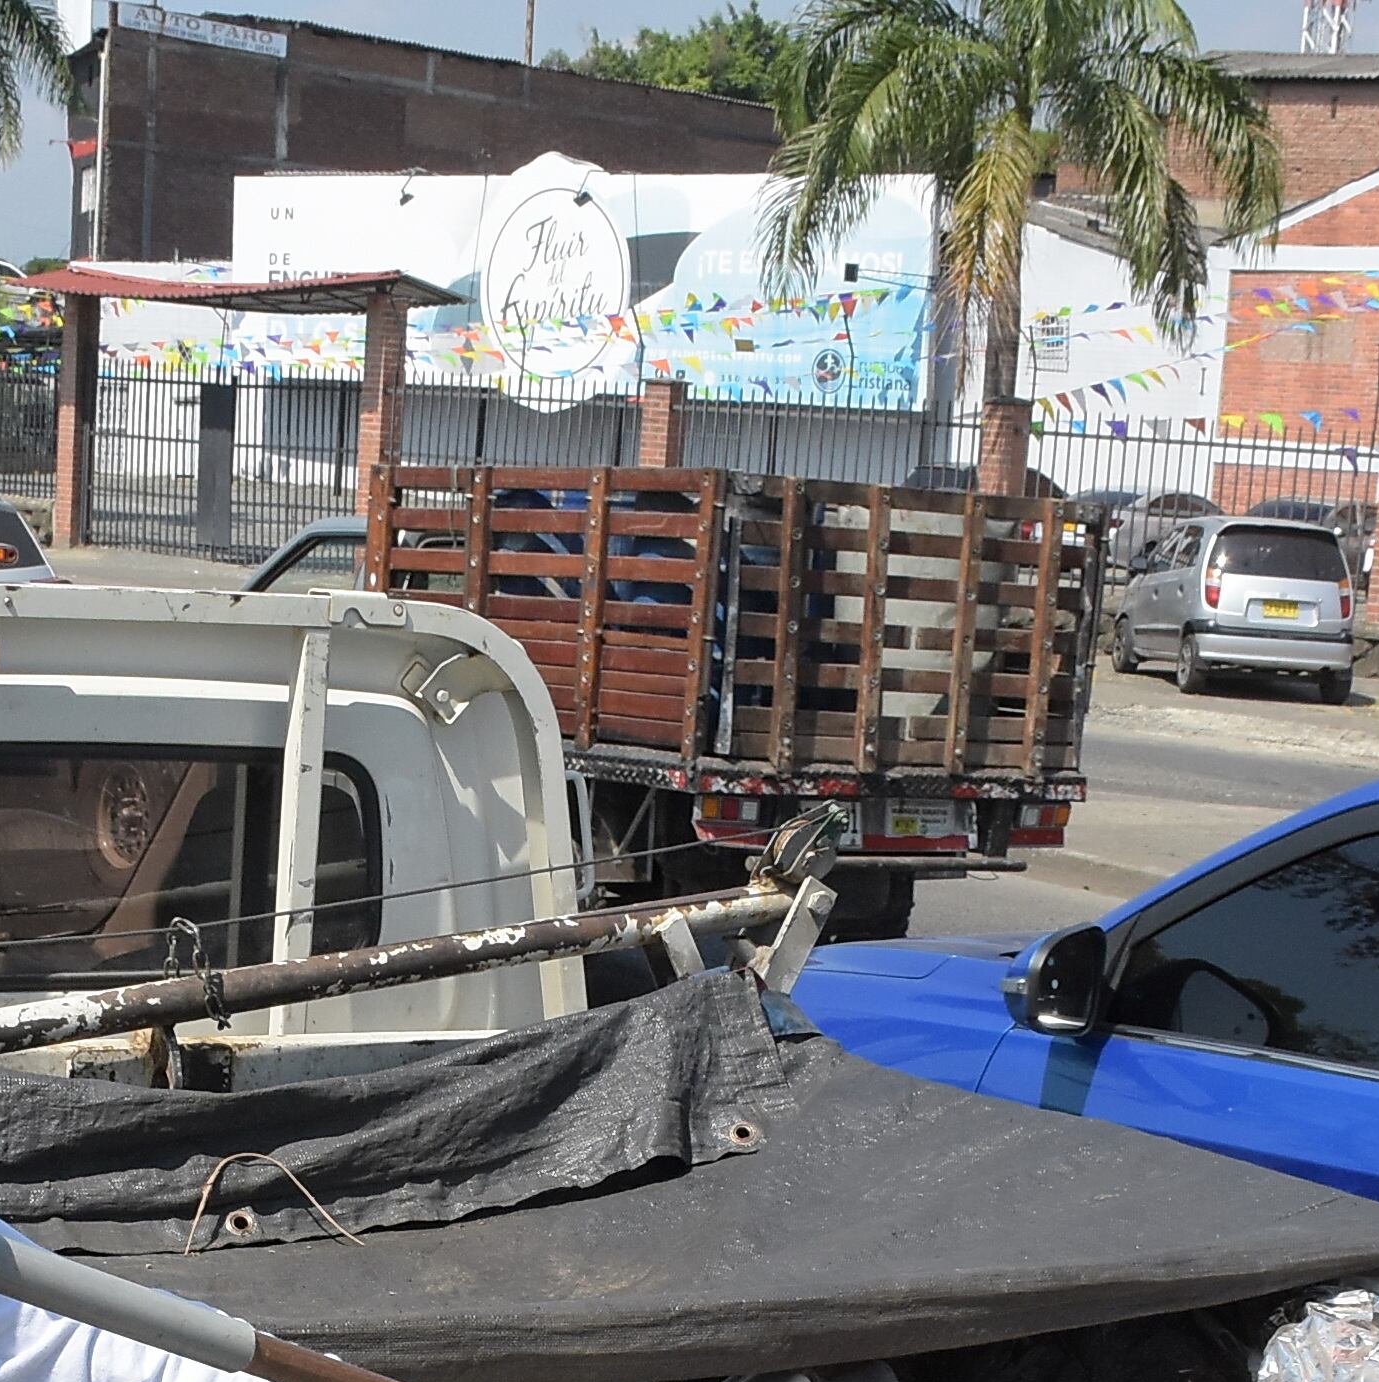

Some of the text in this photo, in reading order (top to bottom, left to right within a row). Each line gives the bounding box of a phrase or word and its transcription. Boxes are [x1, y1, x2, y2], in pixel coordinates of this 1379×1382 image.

[211, 25, 274, 44] FARO
[270, 207, 294, 220] UN
[523, 215, 589, 272] Fluir
[269, 253, 291, 265] DE
[851, 374, 912, 391] ristiana
